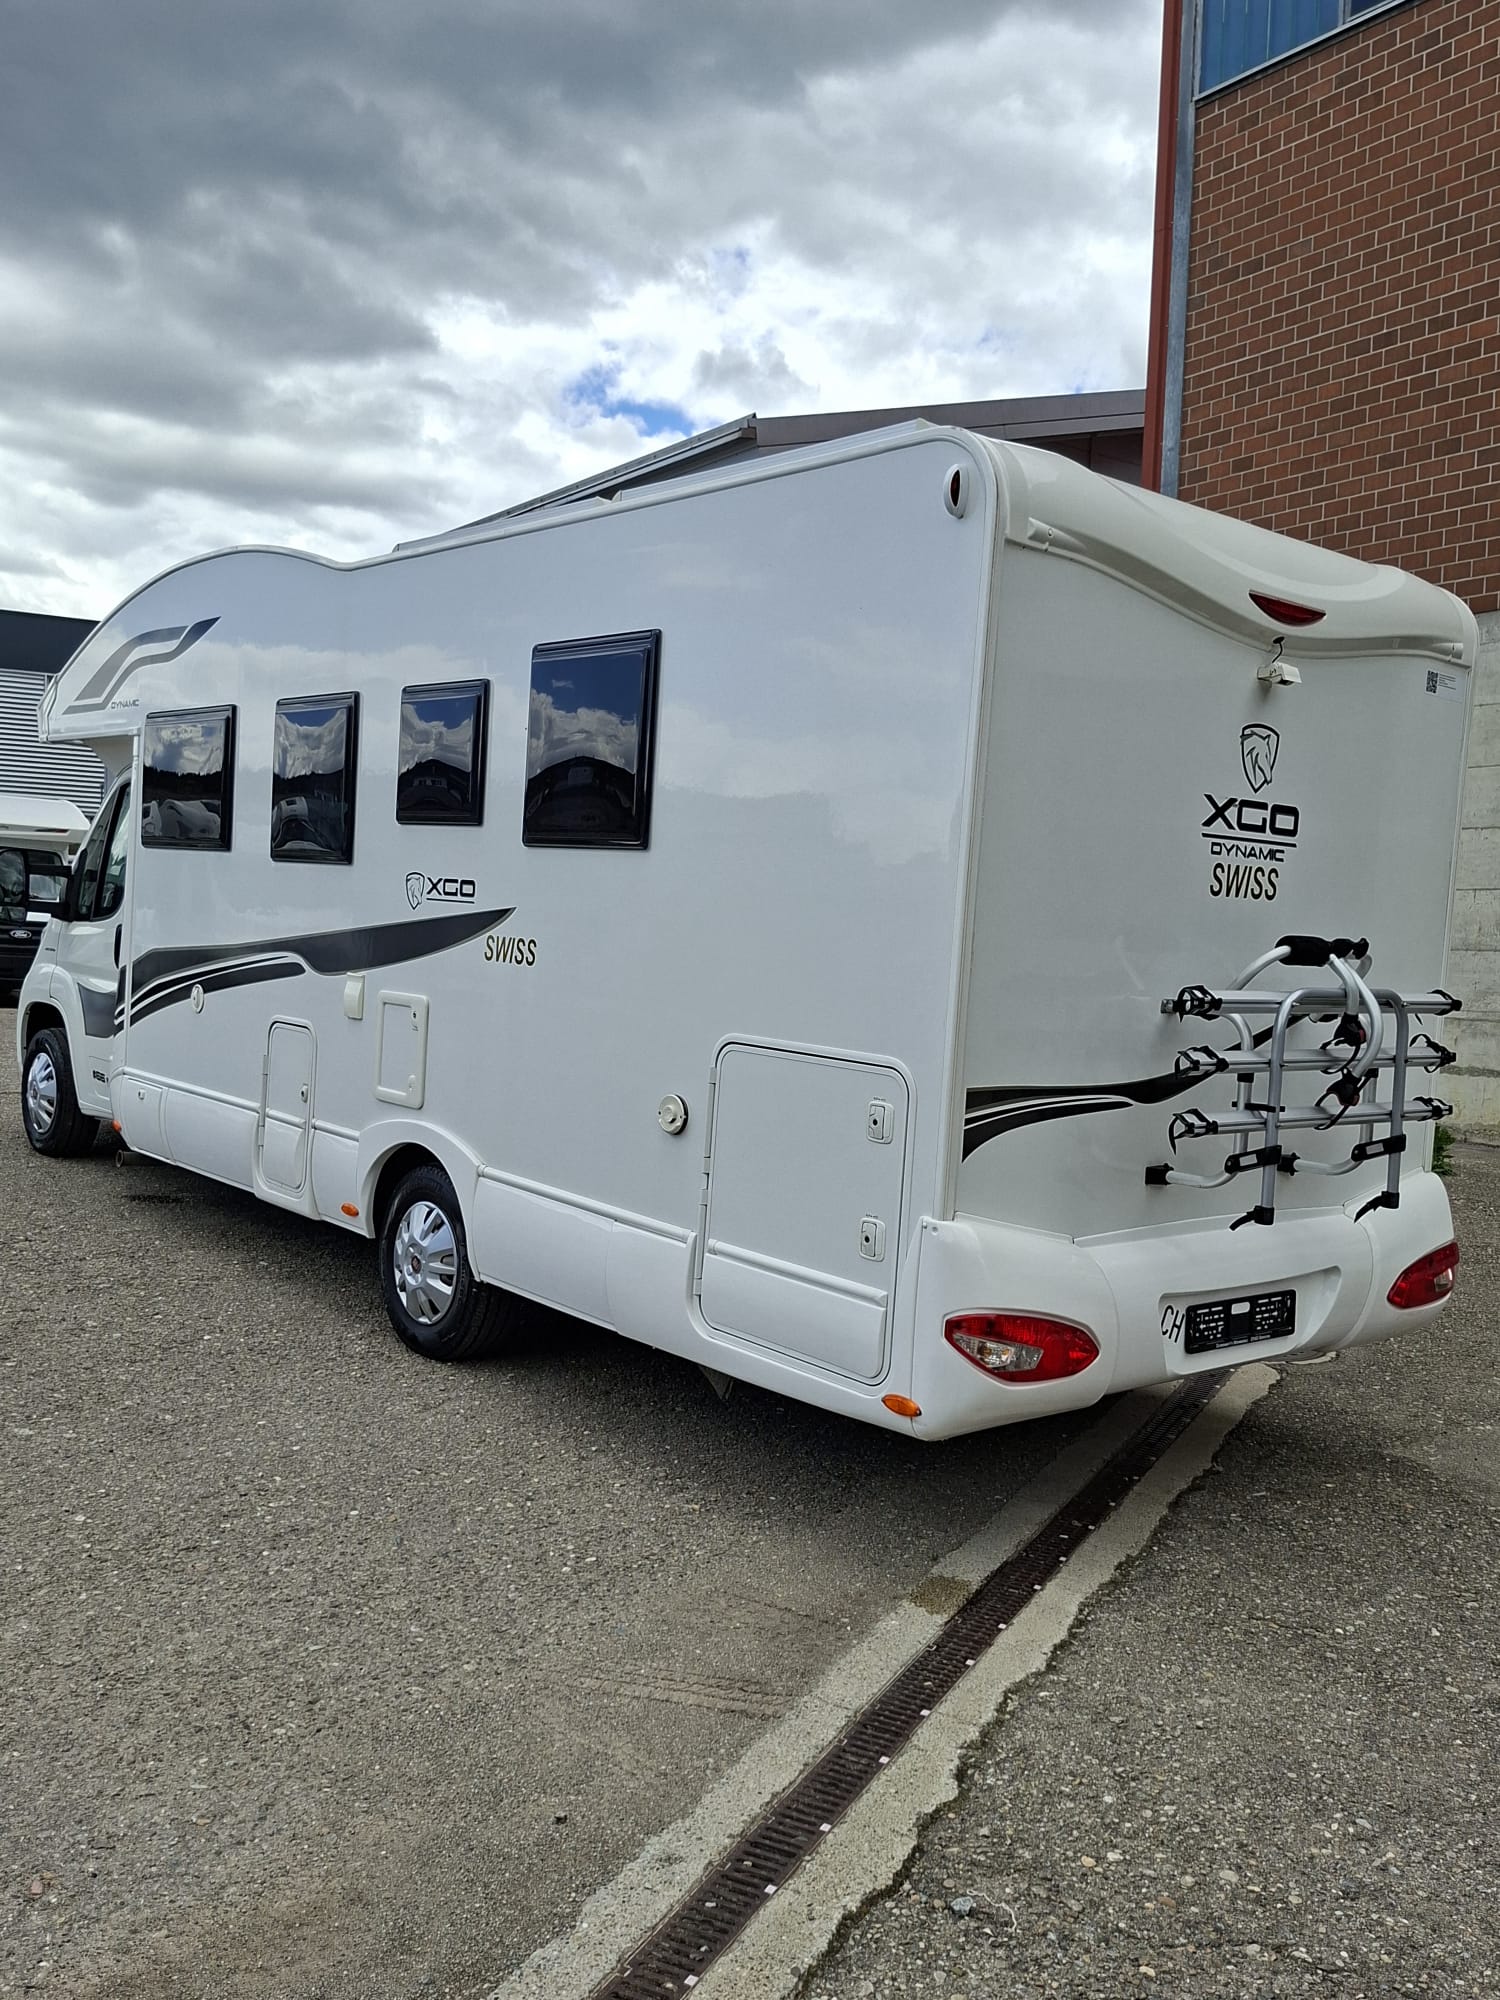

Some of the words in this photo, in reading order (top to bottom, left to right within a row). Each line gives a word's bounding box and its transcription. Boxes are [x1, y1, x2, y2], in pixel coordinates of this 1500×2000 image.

[111, 699, 139, 709] DYNAMIC
[1201, 794, 1299, 837] XGO
[1210, 841, 1285, 862] DYNAMIC
[426, 877, 476, 897] XGO
[1209, 863, 1279, 900] SWISS
[484, 935, 537, 966] SWISS
[1161, 1305, 1185, 1343] CH
